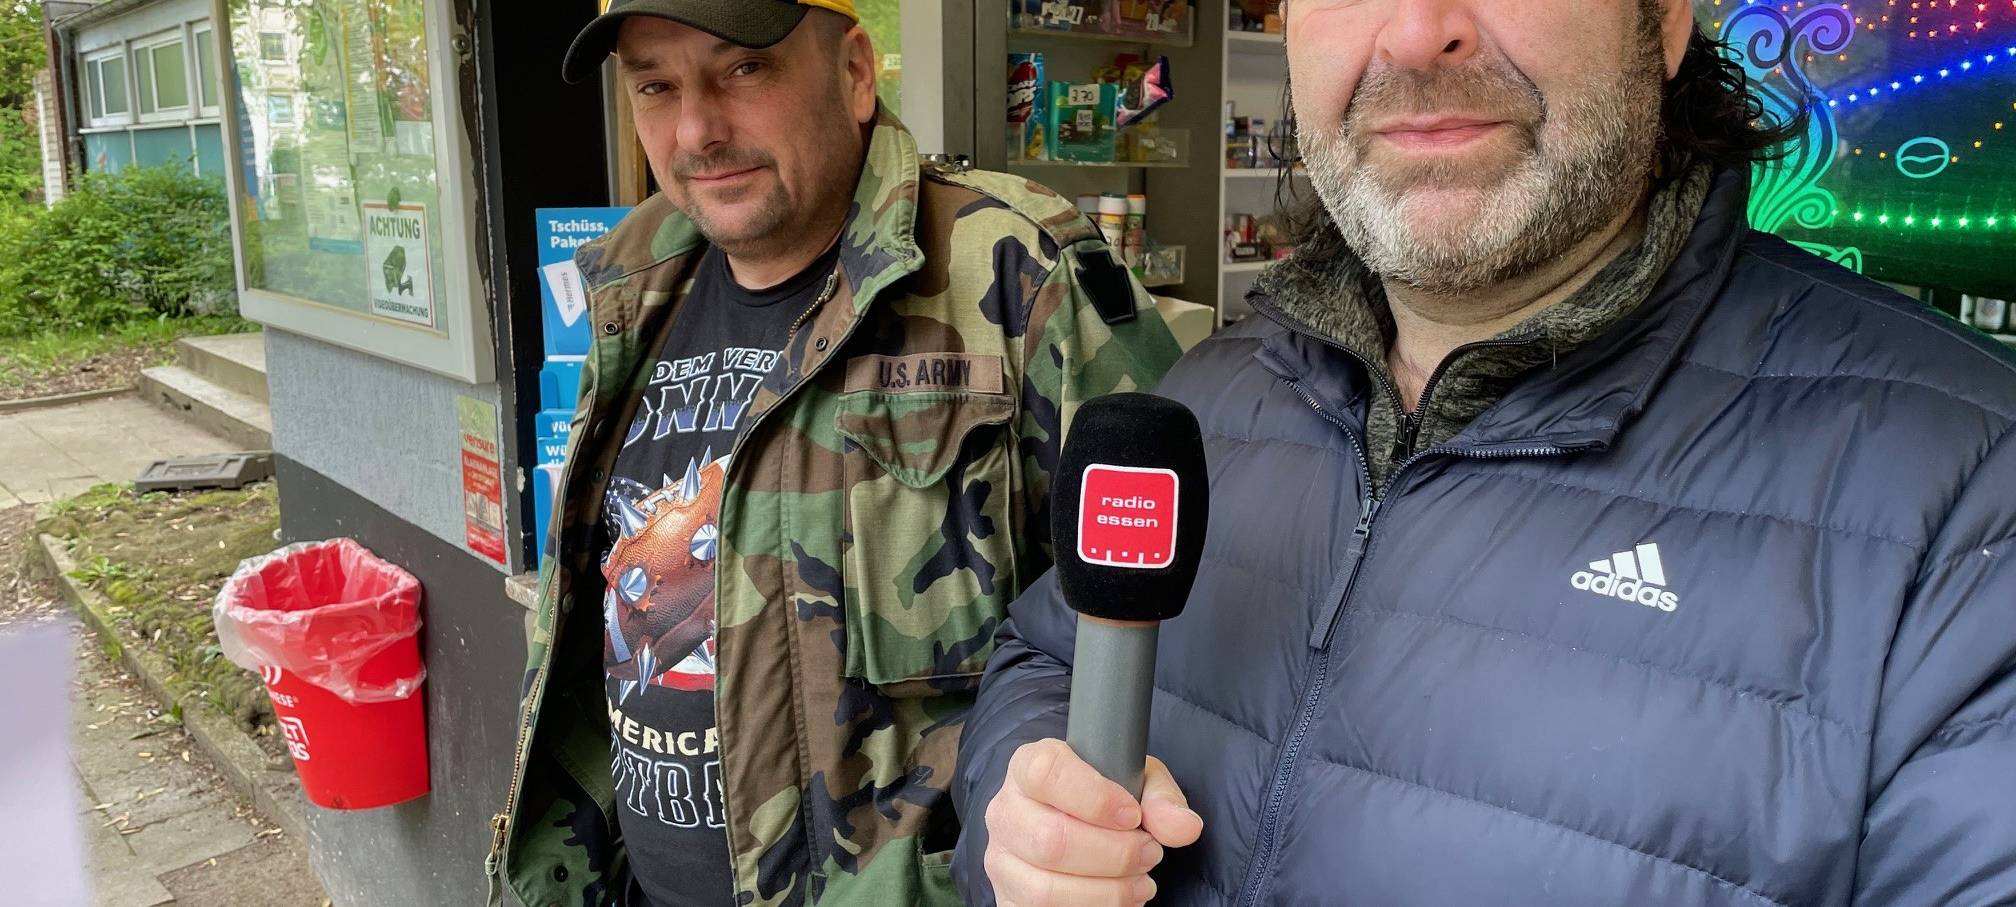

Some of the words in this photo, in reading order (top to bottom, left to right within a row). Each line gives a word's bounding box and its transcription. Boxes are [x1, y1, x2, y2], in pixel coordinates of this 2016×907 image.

[369, 215, 421, 240] ACHTUNG
[548, 219, 609, 234] Tschüss,
[723, 347, 784, 373] VER
[879, 360, 911, 388] U.S.
[915, 358, 971, 386] ARMY
[1101, 495, 1157, 510] radio
[1096, 513, 1159, 529] essen
[1570, 571, 1679, 612] adidas
